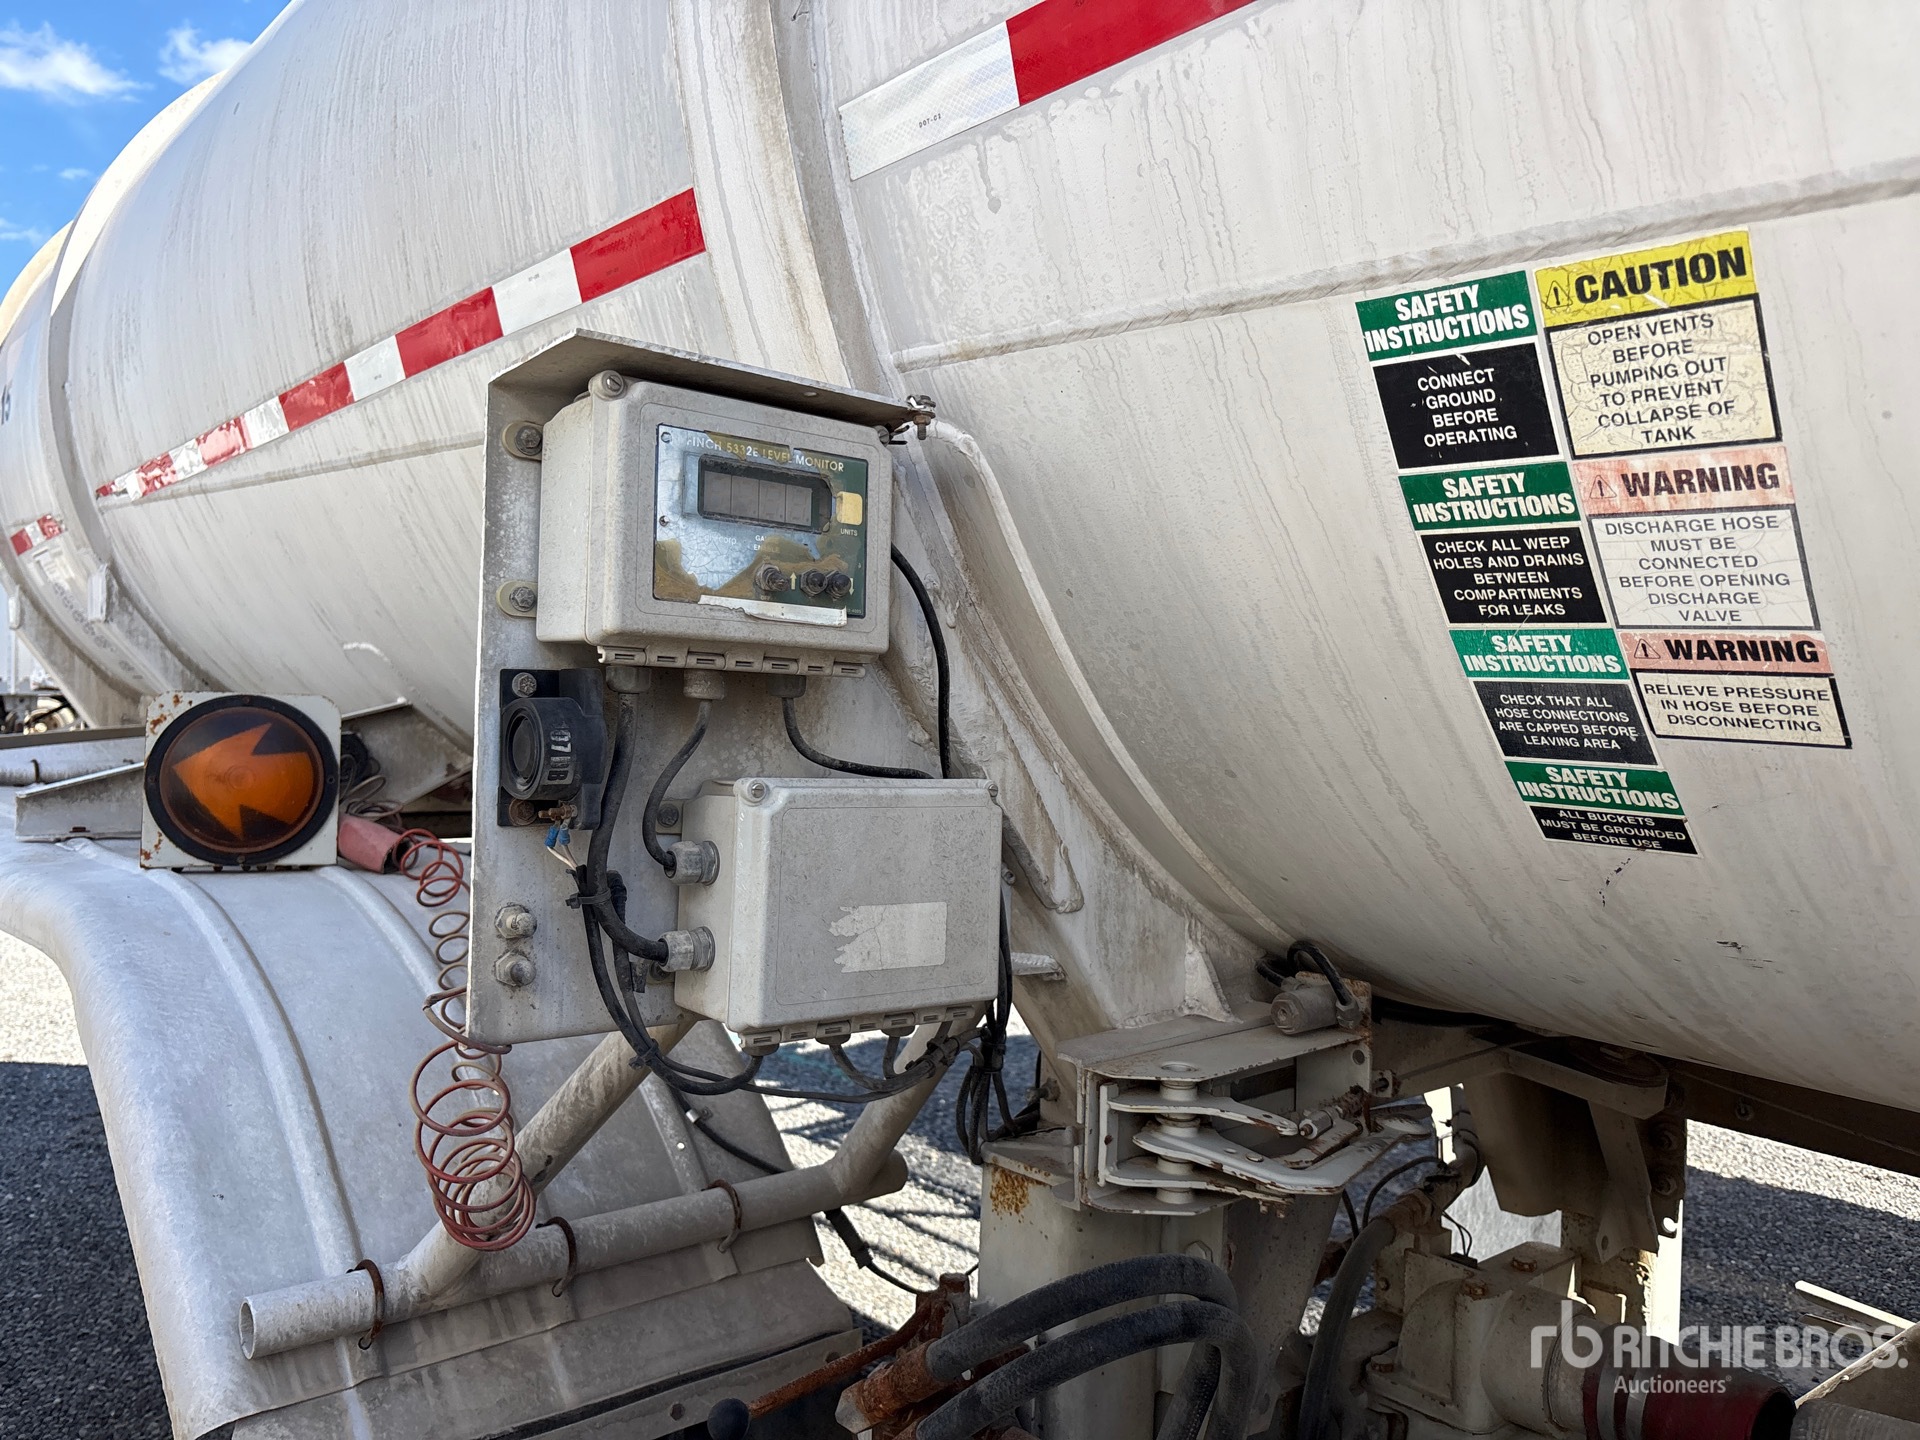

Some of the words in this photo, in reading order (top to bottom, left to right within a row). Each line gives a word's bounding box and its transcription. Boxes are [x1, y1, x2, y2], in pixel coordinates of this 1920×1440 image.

[1575, 247, 1747, 304] CAUTION
[1395, 284, 1479, 321] SAFETY
[1365, 304, 1529, 353] INSTRUCTIONS
[1588, 324, 1641, 345] OPEN
[1647, 314, 1714, 337] VENTS
[1613, 339, 1693, 364] BEFORE
[1417, 368, 1495, 391] CONNECT
[1590, 364, 1678, 388] PUMPING
[1685, 357, 1726, 376] OUT
[1426, 388, 1495, 409] GROUND
[1600, 391, 1626, 407] TO
[1632, 380, 1723, 404] PREVENT
[1433, 408, 1498, 428] BEFORE
[1598, 405, 1699, 427] COLLAPSE
[1708, 400, 1735, 416] OF
[1424, 426, 1517, 447] OPERATING
[1641, 426, 1695, 444] TANK
[796, 455, 844, 472] MONITOR
[1442, 472, 1525, 498] SAFETY
[1621, 463, 1780, 497] WARNING
[1413, 493, 1575, 523] INSTRUCTIONS
[840, 528, 857, 536] UNITS
[1605, 519, 1716, 535] DISCHARGE
[1723, 516, 1779, 530] HOSE
[1435, 539, 1485, 554] CHECK
[1492, 538, 1521, 551] ALL
[1524, 537, 1570, 549] WEEP
[1651, 539, 1701, 551] MUST
[1710, 538, 1736, 550] BE
[1433, 557, 1483, 570] HOLES
[1488, 555, 1519, 568] AND
[1524, 553, 1584, 566] DRAINS
[1639, 555, 1758, 570] CONNECTED
[1474, 571, 1550, 584] BETWEEN
[1620, 575, 1694, 588] BEFORE
[1700, 573, 1790, 587] OPENING
[1454, 587, 1582, 600] COMPARTMENTS
[1649, 592, 1760, 605] DISCHARGE
[1479, 605, 1510, 616] FOR
[1515, 604, 1566, 615] LEAKS
[1679, 610, 1741, 622] VALVE
[1491, 634, 1572, 652] SAFETY
[1664, 640, 1819, 663] WARNING
[1464, 655, 1621, 673] INSTRUCTIONS
[1500, 694, 1545, 706] CHECK
[1549, 696, 1580, 706] THAT
[1586, 697, 1612, 708] ALL
[1644, 684, 1718, 696] RELIEVE
[1724, 687, 1830, 701] PRESSURE
[1495, 708, 1530, 719] HOSE
[1533, 709, 1629, 722] CONNECTIONS
[1661, 700, 1677, 710] IN
[1684, 701, 1734, 713] HOSE
[1740, 703, 1819, 716] BEFORE
[1500, 722, 1524, 732] ARE
[1527, 723, 1578, 735] CAPPED
[1583, 725, 1638, 737] BEFORE
[1668, 715, 1821, 732] DISCONNECTING
[1524, 735, 1579, 747] LEAVING
[1583, 738, 1621, 750] AREA
[1545, 767, 1628, 787] SAFETY
[1517, 781, 1679, 809] INSTRUCTIONS
[1559, 810, 1585, 819] ALL
[1589, 813, 1655, 826] BUCKETS
[1541, 819, 1577, 829] MUST
[1581, 823, 1600, 831] BE
[1603, 825, 1686, 841] GROUNDED
[1573, 833, 1629, 846] BEFORE
[1634, 839, 1662, 849] USE
